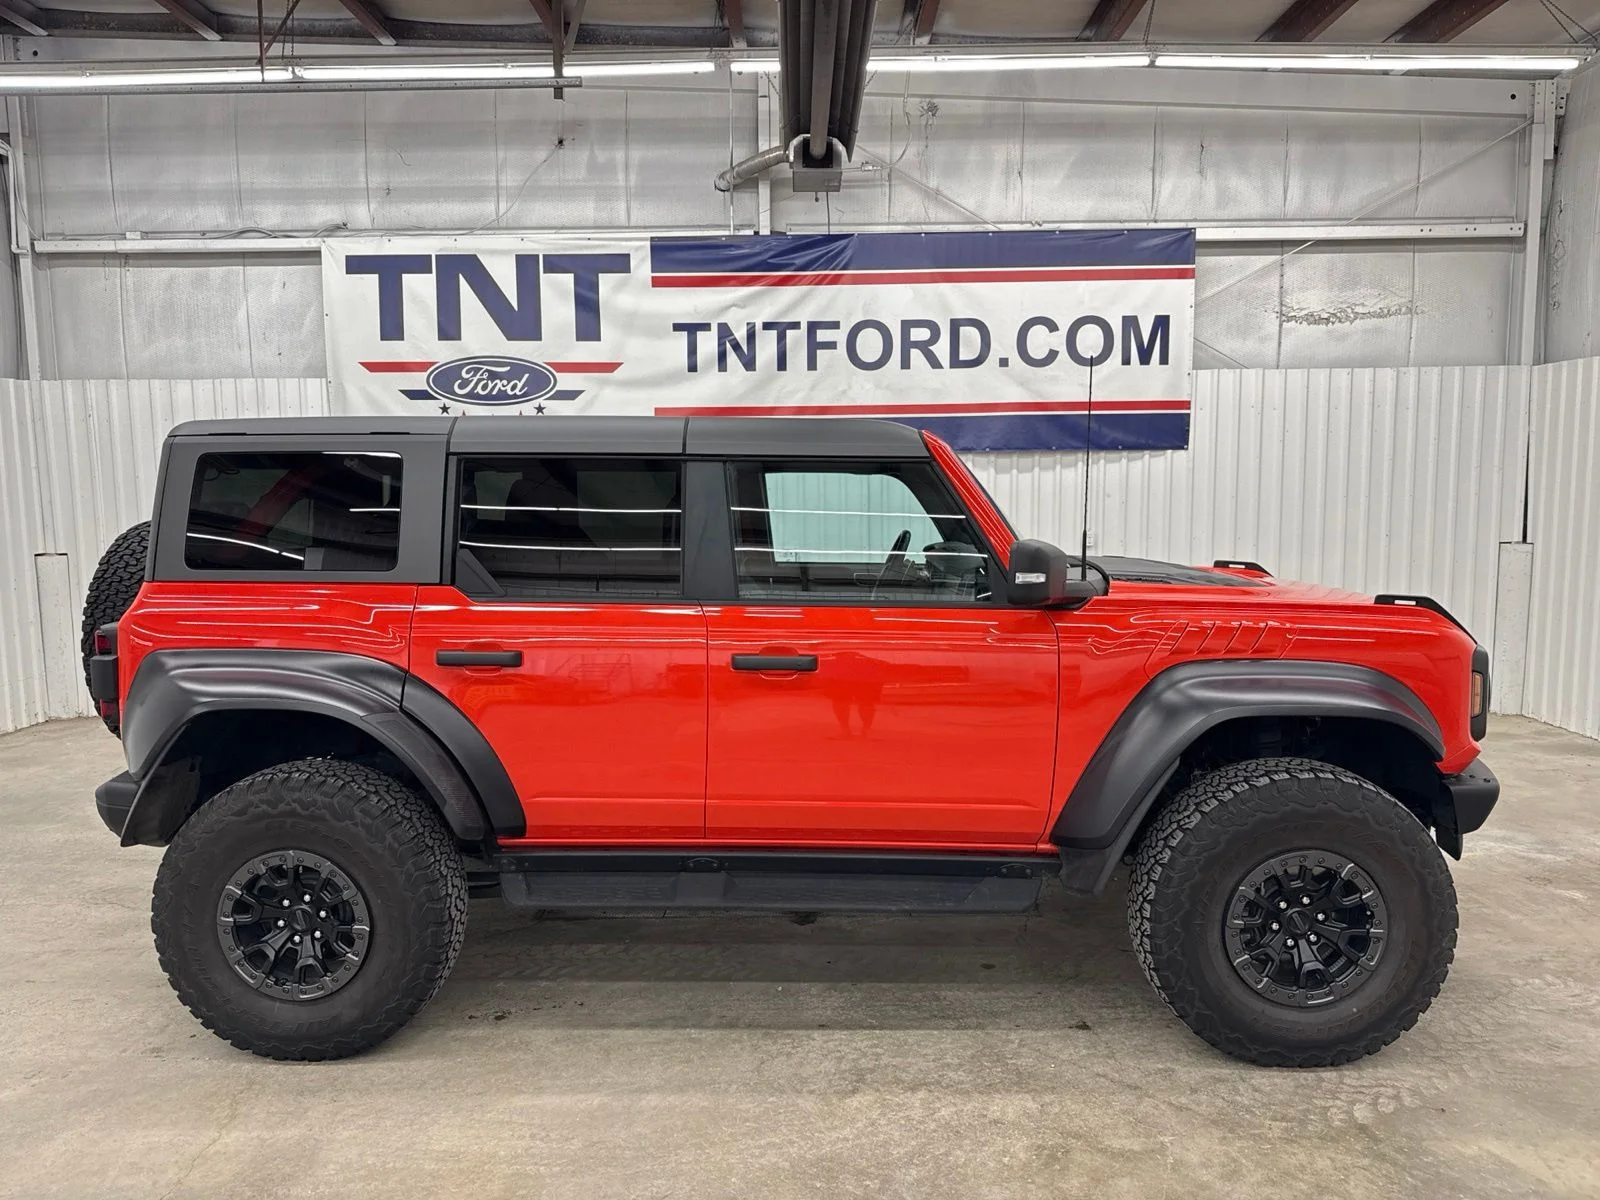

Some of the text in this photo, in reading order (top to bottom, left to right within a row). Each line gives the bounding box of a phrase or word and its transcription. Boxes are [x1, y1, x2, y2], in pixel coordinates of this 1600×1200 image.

[345, 253, 631, 342] TNT
[672, 315, 1170, 373] TNTFORD.COM
[453, 364, 529, 396] Ford
